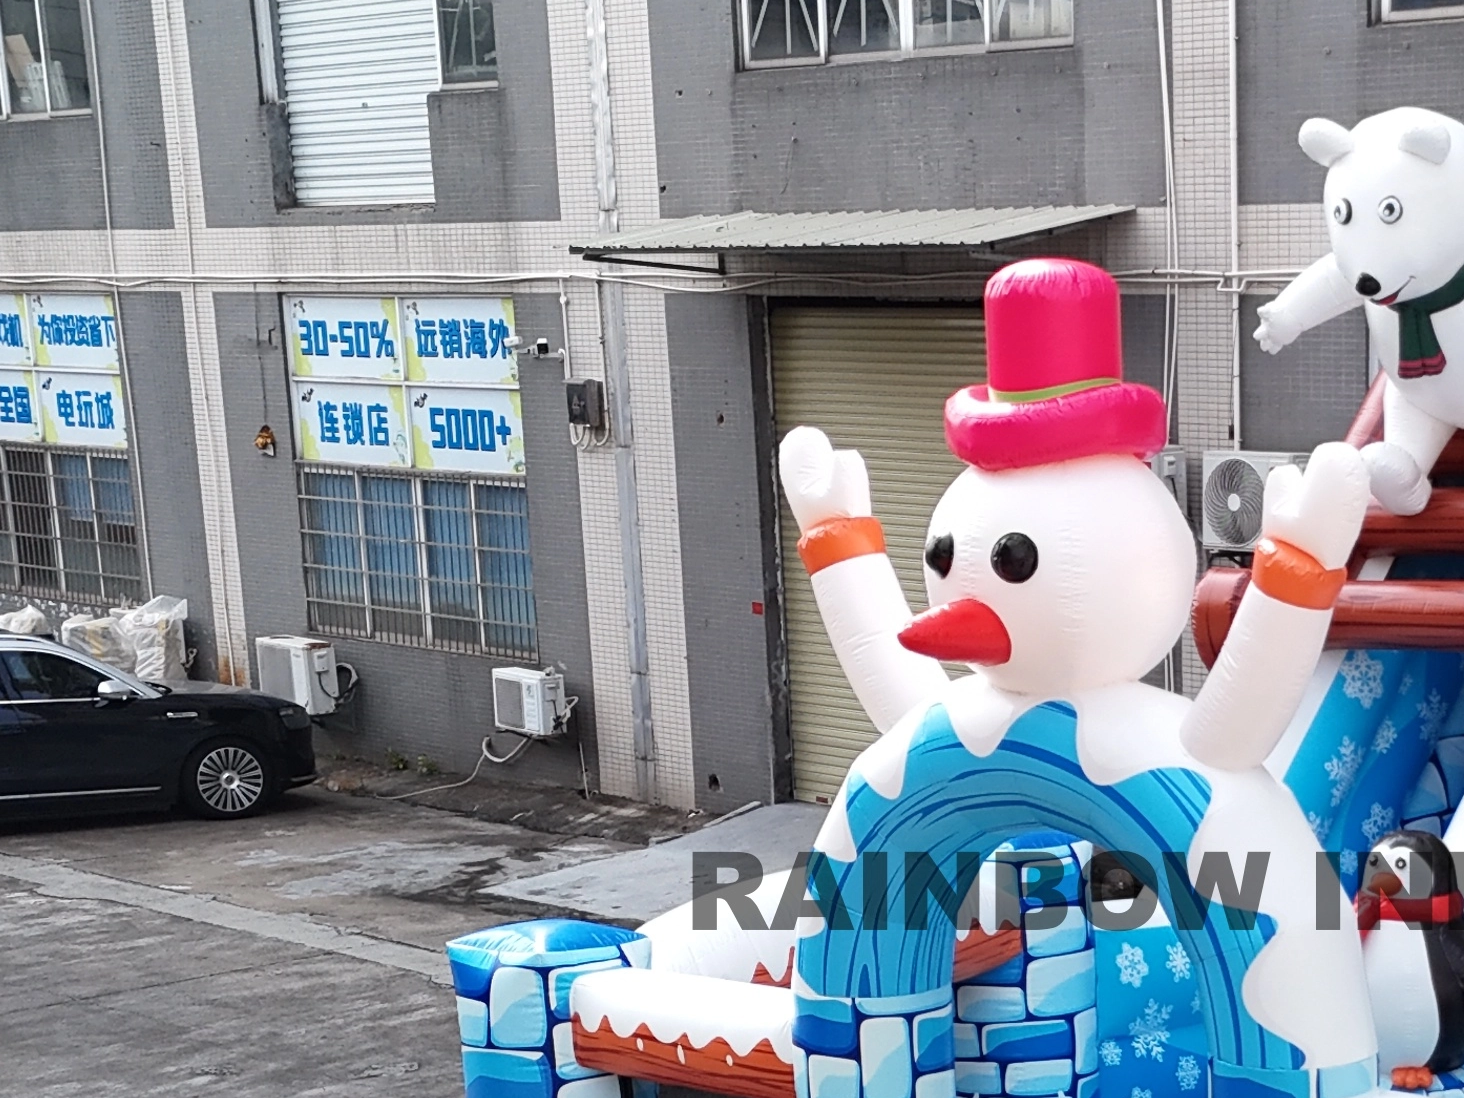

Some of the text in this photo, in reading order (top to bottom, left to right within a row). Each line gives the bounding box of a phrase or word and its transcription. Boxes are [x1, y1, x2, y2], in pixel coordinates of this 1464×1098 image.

[299, 319, 394, 358] 30-50%
[415, 318, 512, 359] 远销海外
[0, 386, 32, 423] 全国
[56, 390, 115, 429] 电玩城
[317, 401, 390, 446] 连锁店
[429, 407, 512, 452] 5000+
